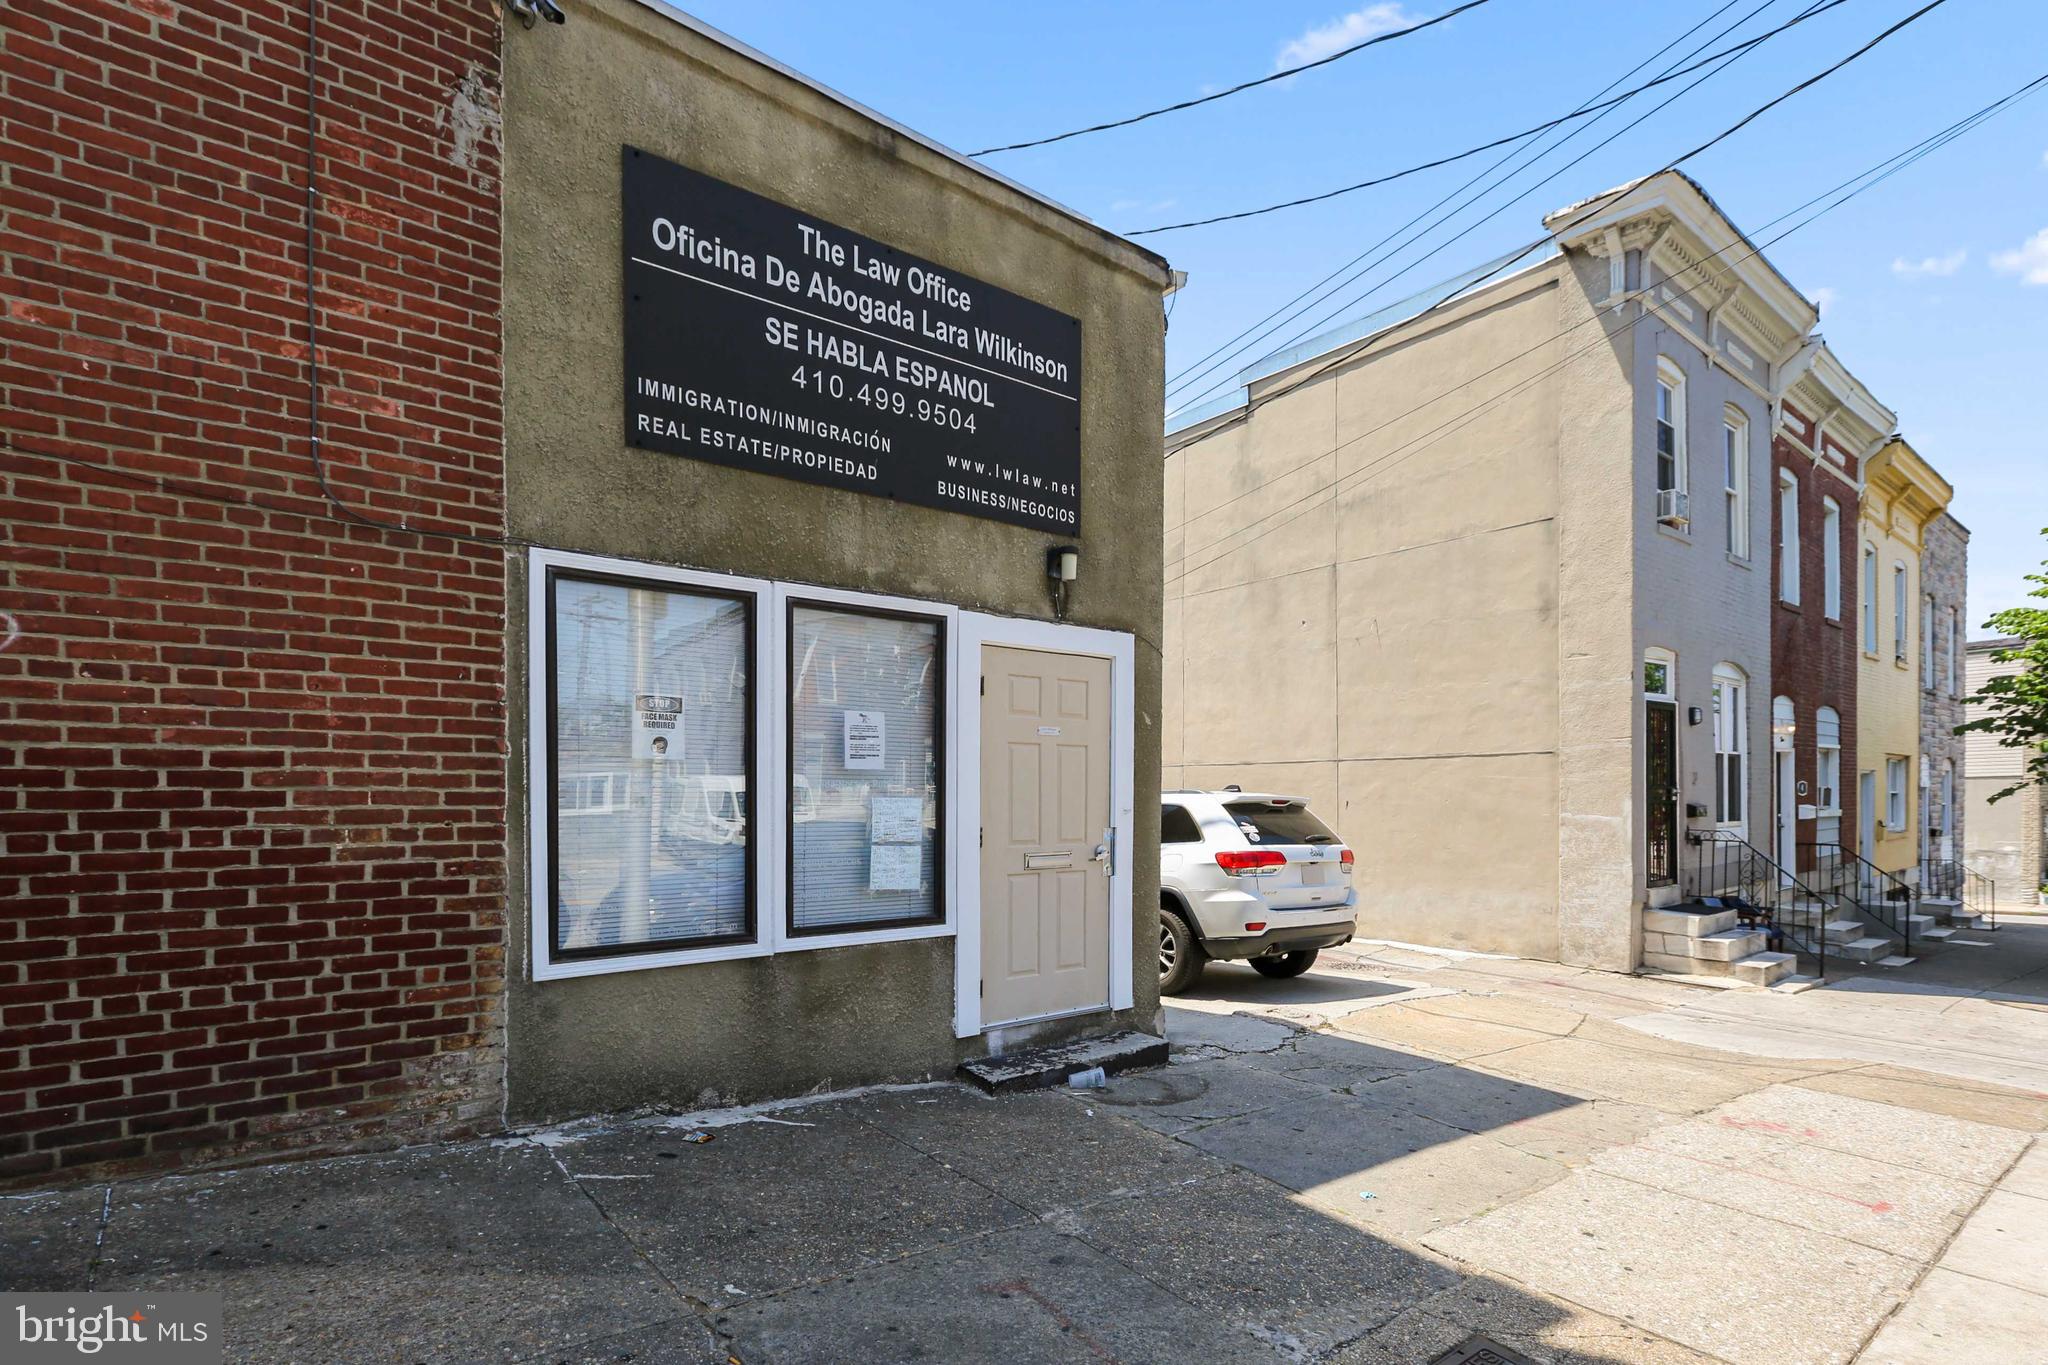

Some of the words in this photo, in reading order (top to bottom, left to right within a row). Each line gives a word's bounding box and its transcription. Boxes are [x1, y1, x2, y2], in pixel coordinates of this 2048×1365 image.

[653, 217, 757, 280] Oficina
[767, 255, 801, 293] De
[806, 272, 915, 332] Abogada
[923, 310, 969, 350] Lara
[975, 327, 1068, 383] Wilkinson
[798, 224, 846, 267] The
[854, 245, 901, 287] Law
[908, 267, 972, 312] Office
[766, 317, 799, 351] SE
[808, 329, 890, 378] HABLA
[896, 356, 995, 408] ESPANOL
[638, 377, 891, 453] IMMIGRATION/INMIGRACIÓN
[791, 366, 977, 435] 410.499.9504
[638, 414, 691, 441] REAL
[701, 428, 878, 481] ESTATE/PROPIEDAD
[947, 455, 1075, 497] www.lwlaw.net
[938, 481, 1075, 524] BUSINESS/NEGOCIOS
[641, 712, 657, 721] FACE
[658, 712, 678, 722] MASK
[643, 720, 676, 730] REQUIRED
[648, 698, 671, 709] STOP
